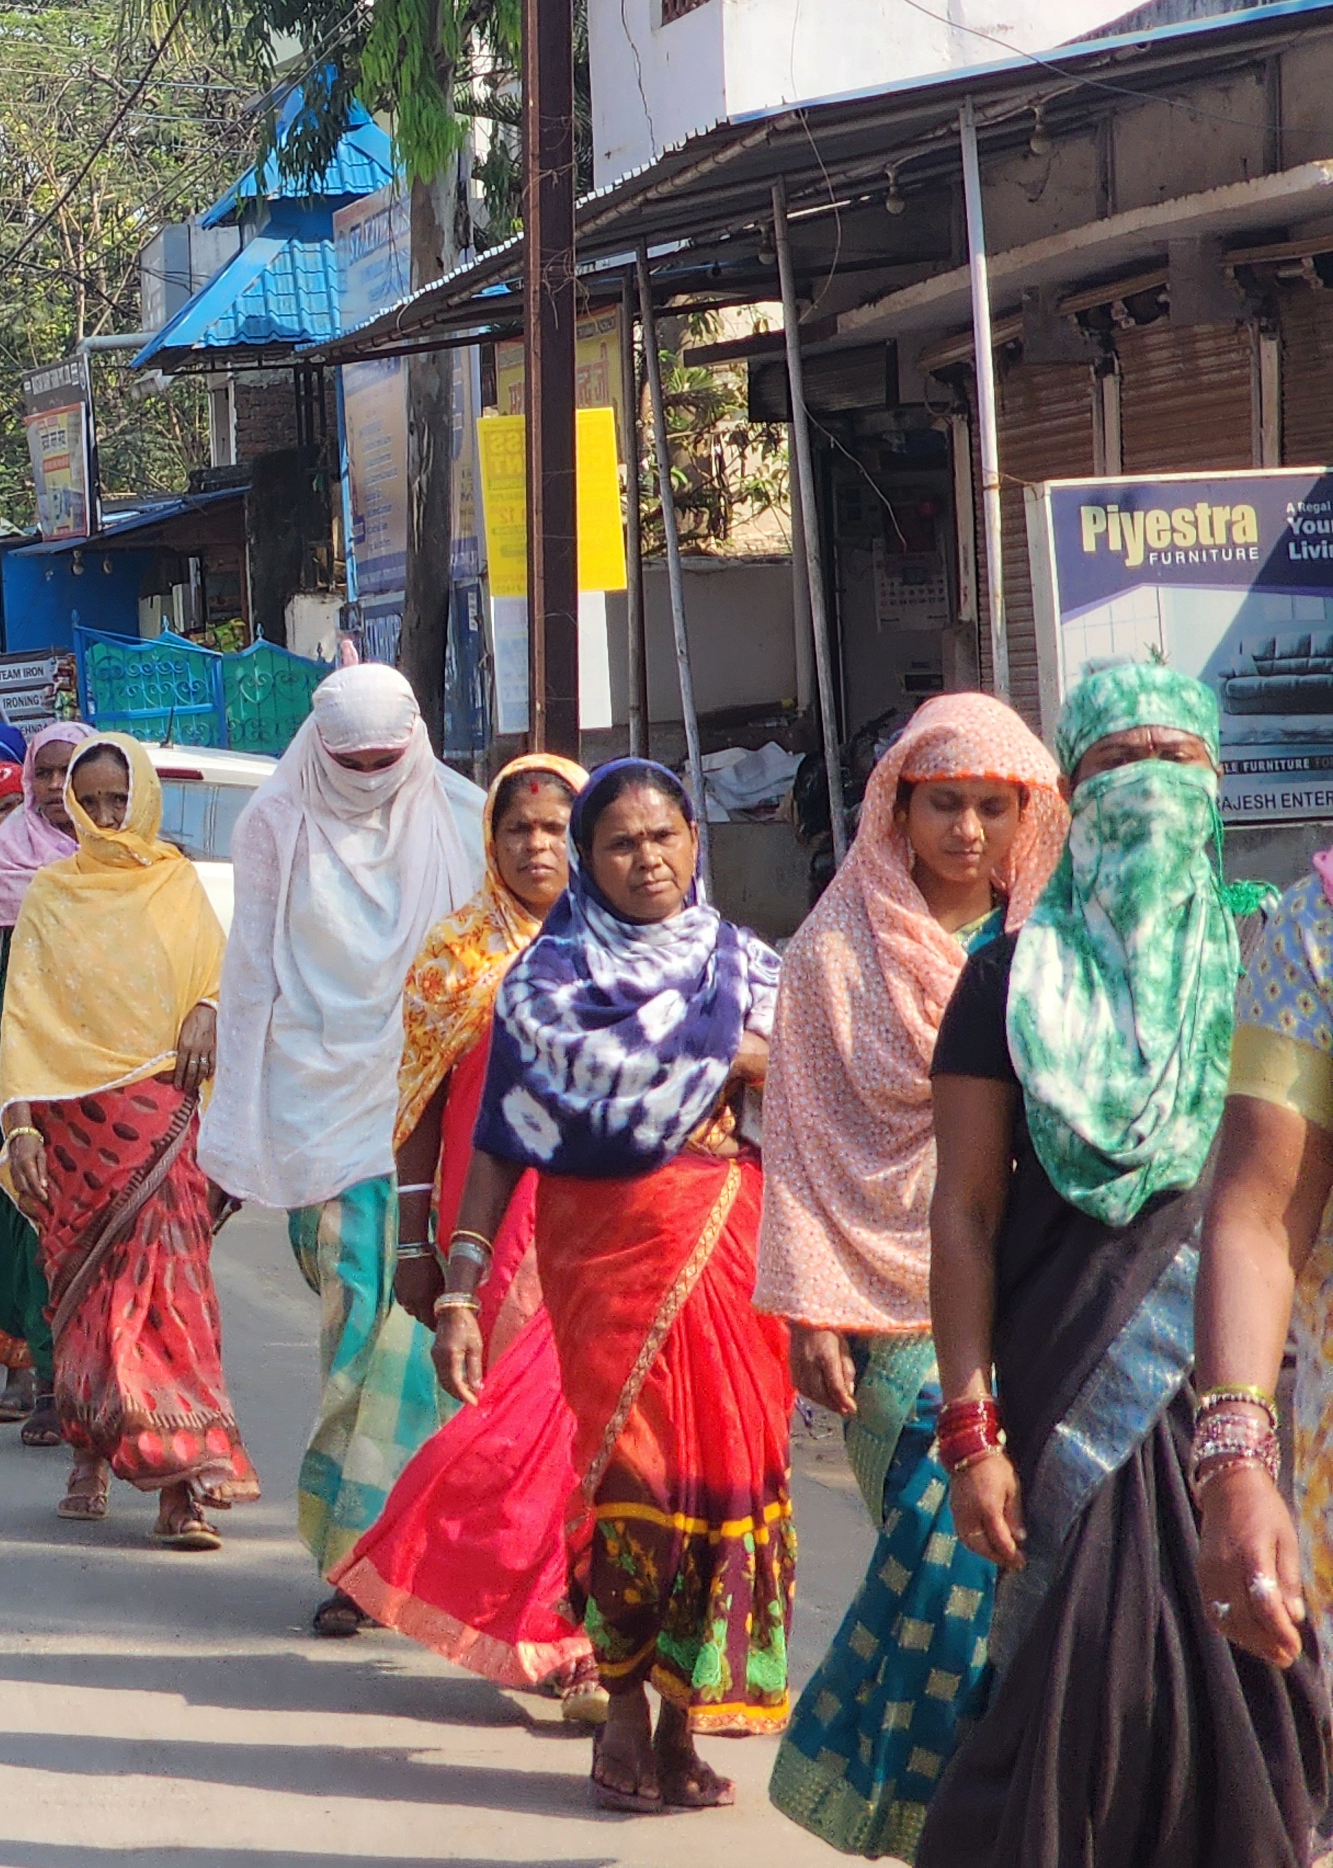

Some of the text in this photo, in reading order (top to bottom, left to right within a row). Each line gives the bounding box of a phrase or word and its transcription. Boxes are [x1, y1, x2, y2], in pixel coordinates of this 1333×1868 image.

[1297, 500, 1331, 515] Regal
[1286, 517, 1333, 535] You
[1081, 502, 1258, 567] Piyestra
[1149, 547, 1259, 566] FURNITURE
[23, 666, 44, 678] IRON
[3, 695, 40, 709] IRONING
[1242, 758, 1310, 772] FURNITURE
